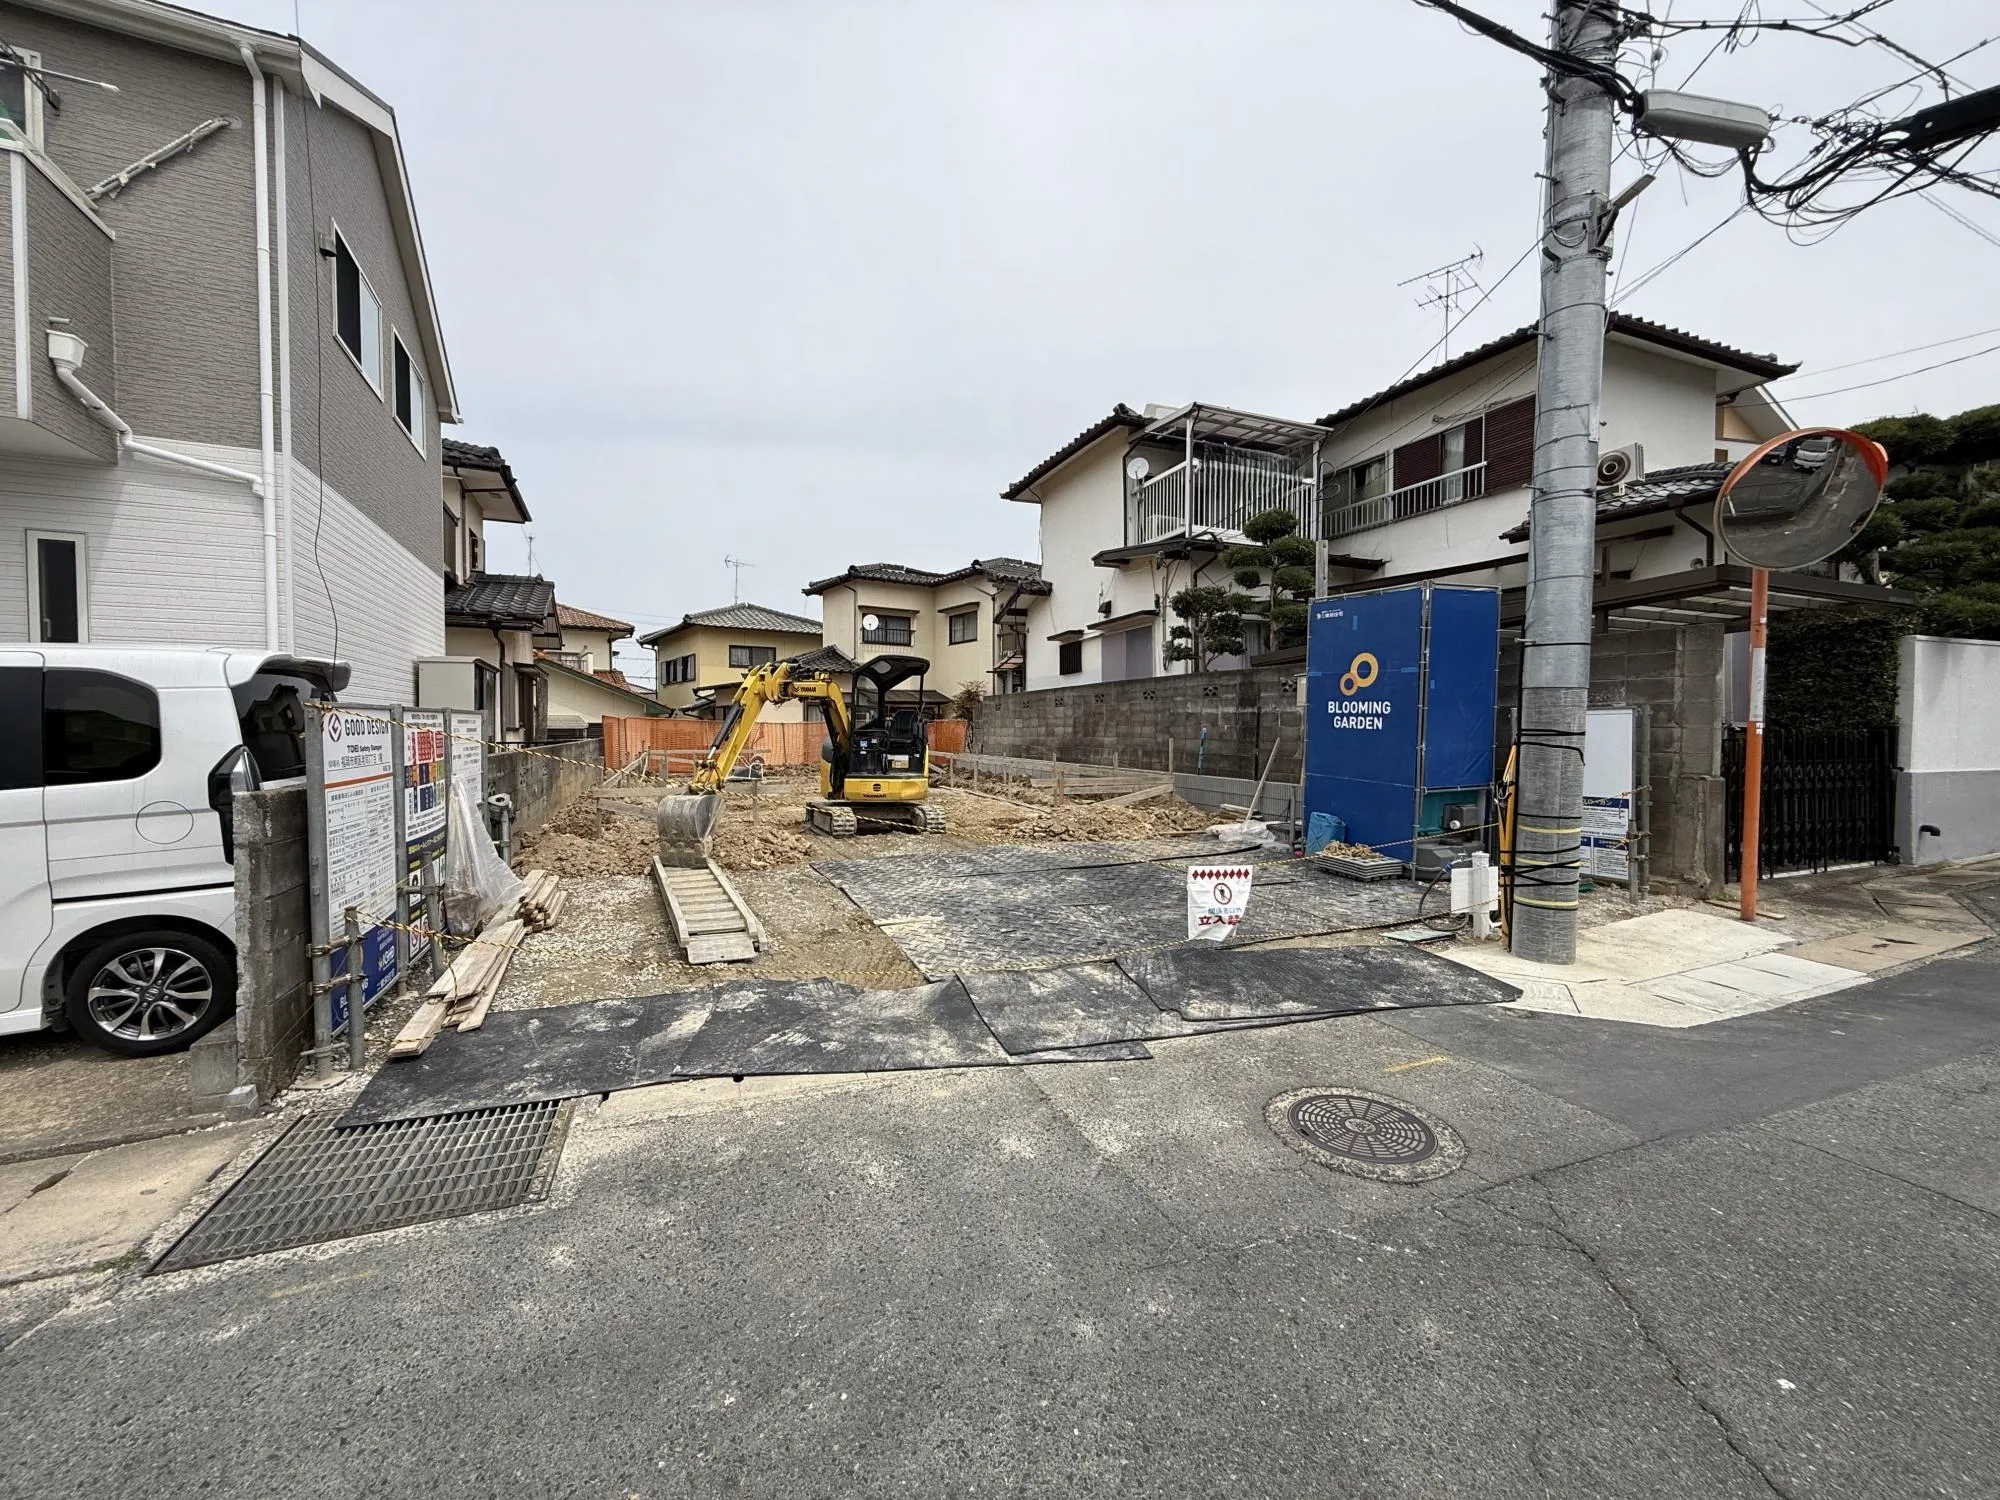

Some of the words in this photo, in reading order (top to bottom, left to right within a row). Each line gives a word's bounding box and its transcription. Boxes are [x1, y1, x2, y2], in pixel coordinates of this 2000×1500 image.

[1327, 701, 1391, 714] BLOOMING
[345, 718, 365, 736] GOOD
[367, 718, 389, 735] DESIGN
[1333, 716, 1383, 730] GARDEN
[1208, 907, 1242, 915] 関係者以外
